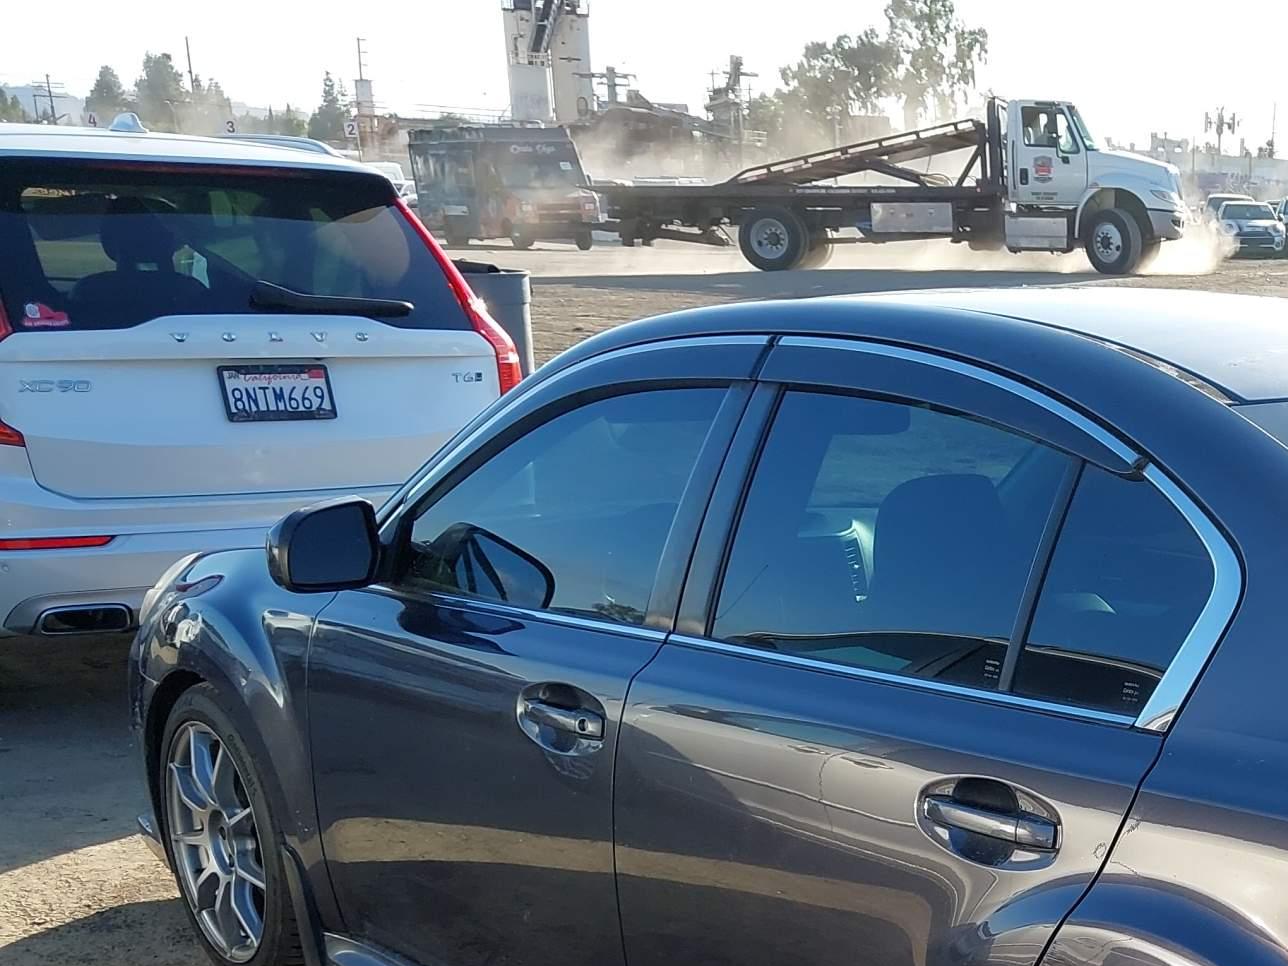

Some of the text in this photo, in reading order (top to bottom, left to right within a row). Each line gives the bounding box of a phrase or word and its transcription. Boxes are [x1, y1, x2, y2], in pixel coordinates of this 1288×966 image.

[88, 114, 97, 127] 4
[226, 120, 236, 133] 3
[347, 126, 356, 136] 2
[169, 332, 369, 343] VOLVO
[231, 385, 326, 413] 8NTM669
